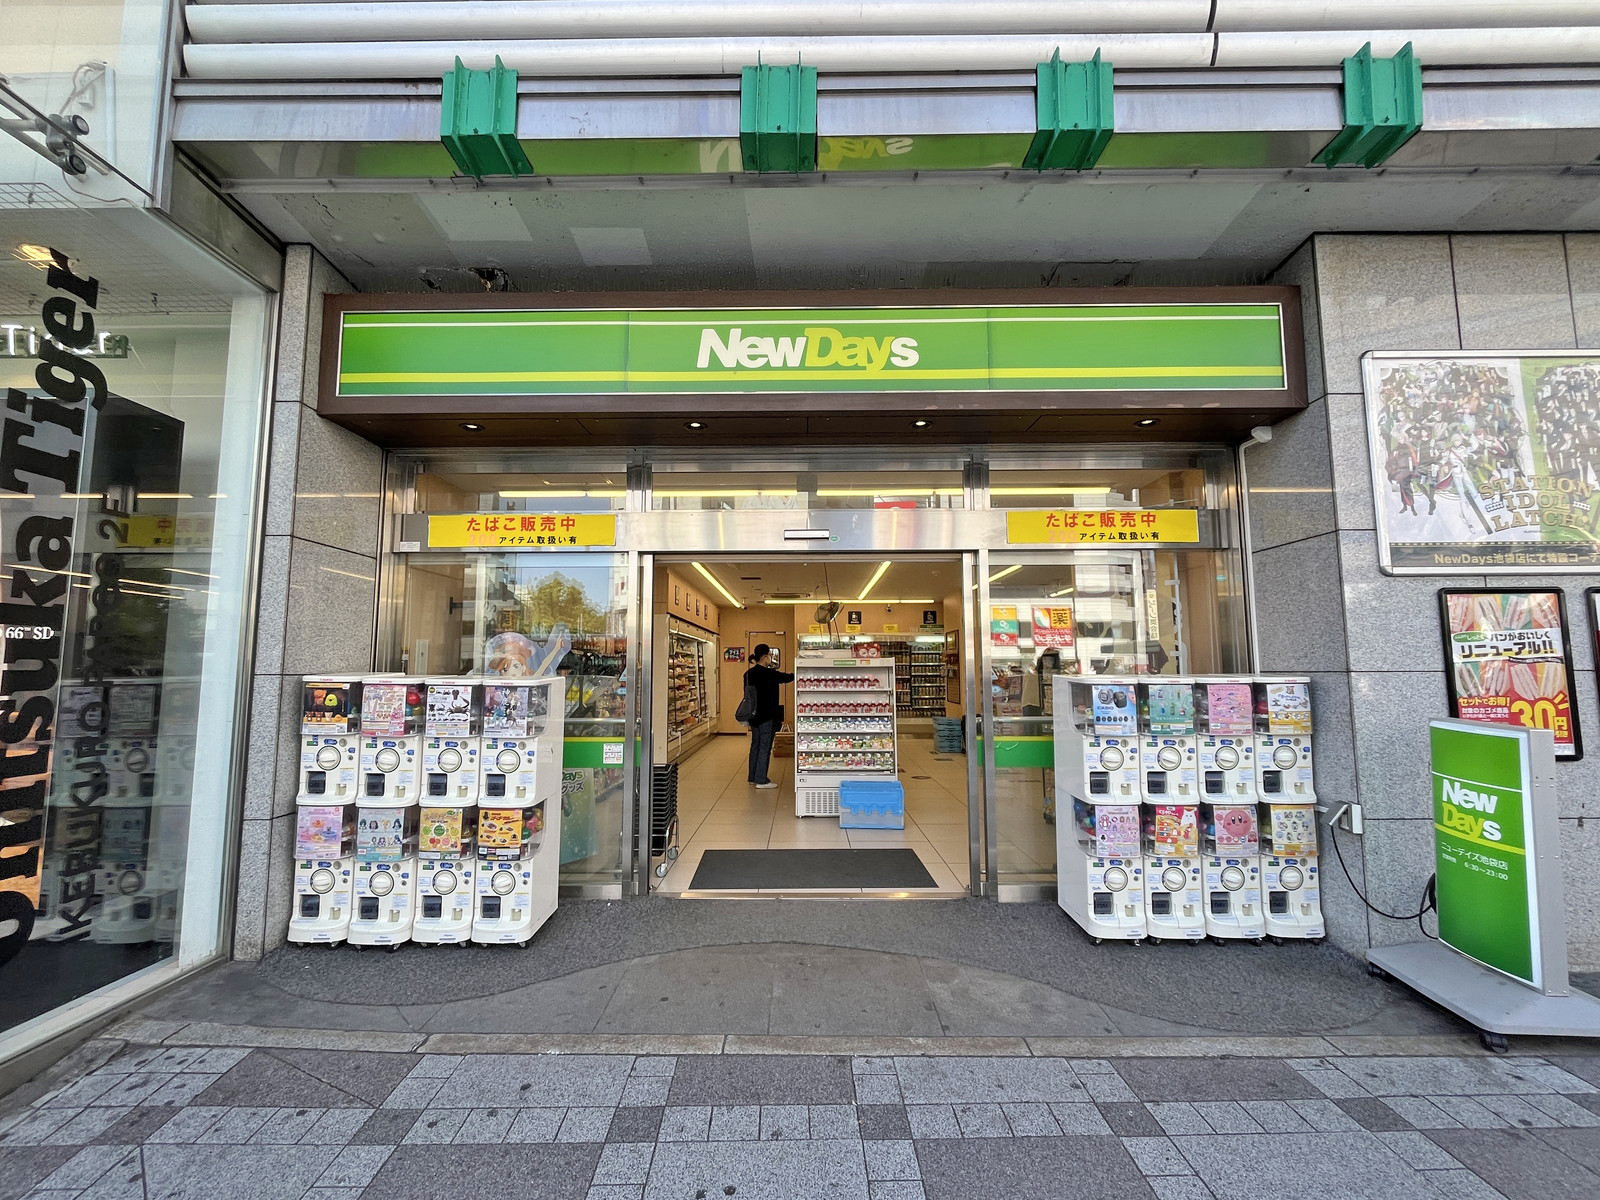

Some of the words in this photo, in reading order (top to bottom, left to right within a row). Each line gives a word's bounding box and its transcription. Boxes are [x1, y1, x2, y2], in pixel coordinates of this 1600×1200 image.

[696, 327, 920, 372] NewDays
[0, 247, 108, 494] Tiger
[1478, 475, 1594, 500] STATION
[1504, 492, 1571, 512] IDOL
[466, 515, 577, 532] たばこ販売中
[1045, 512, 1157, 528] たばこ販売中
[33, 626, 55, 640] SD
[1490, 630, 1551, 643] パンがおいしく
[1441, 778, 1498, 814] New
[1441, 801, 1502, 841] Days
